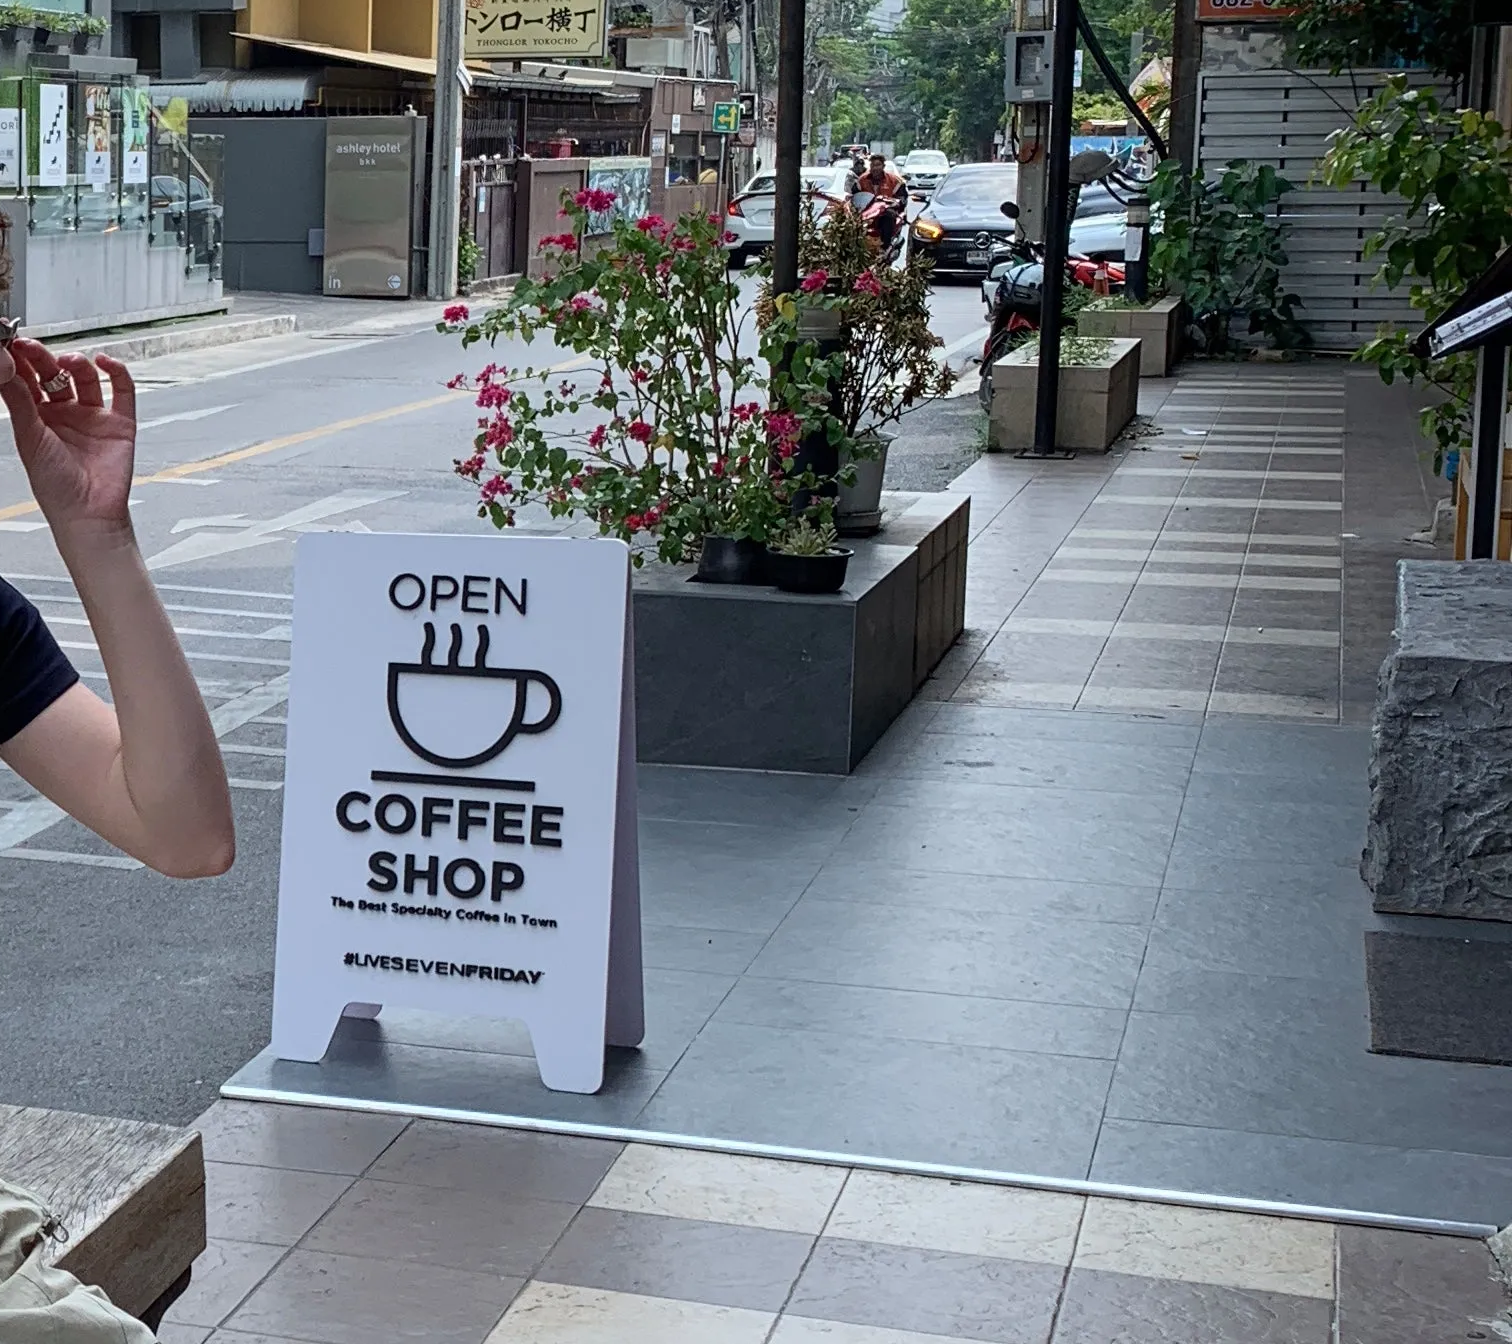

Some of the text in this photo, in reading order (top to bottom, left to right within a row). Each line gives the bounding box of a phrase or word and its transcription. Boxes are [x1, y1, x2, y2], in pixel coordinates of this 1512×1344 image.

[476, 38, 579, 47] THONGLOR YOKOCHO
[336, 142, 401, 155] ashley hotel
[328, 275, 341, 289] in
[388, 572, 528, 616] OPEN
[336, 790, 564, 849] COFFEE
[366, 850, 525, 903] SHOP
[331, 896, 354, 910] The
[358, 899, 387, 913] Best
[391, 902, 452, 920] Specialty
[455, 908, 500, 924] Coffee
[521, 914, 558, 929] Town
[343, 951, 544, 985] #LIVESEVENFRIDAY
